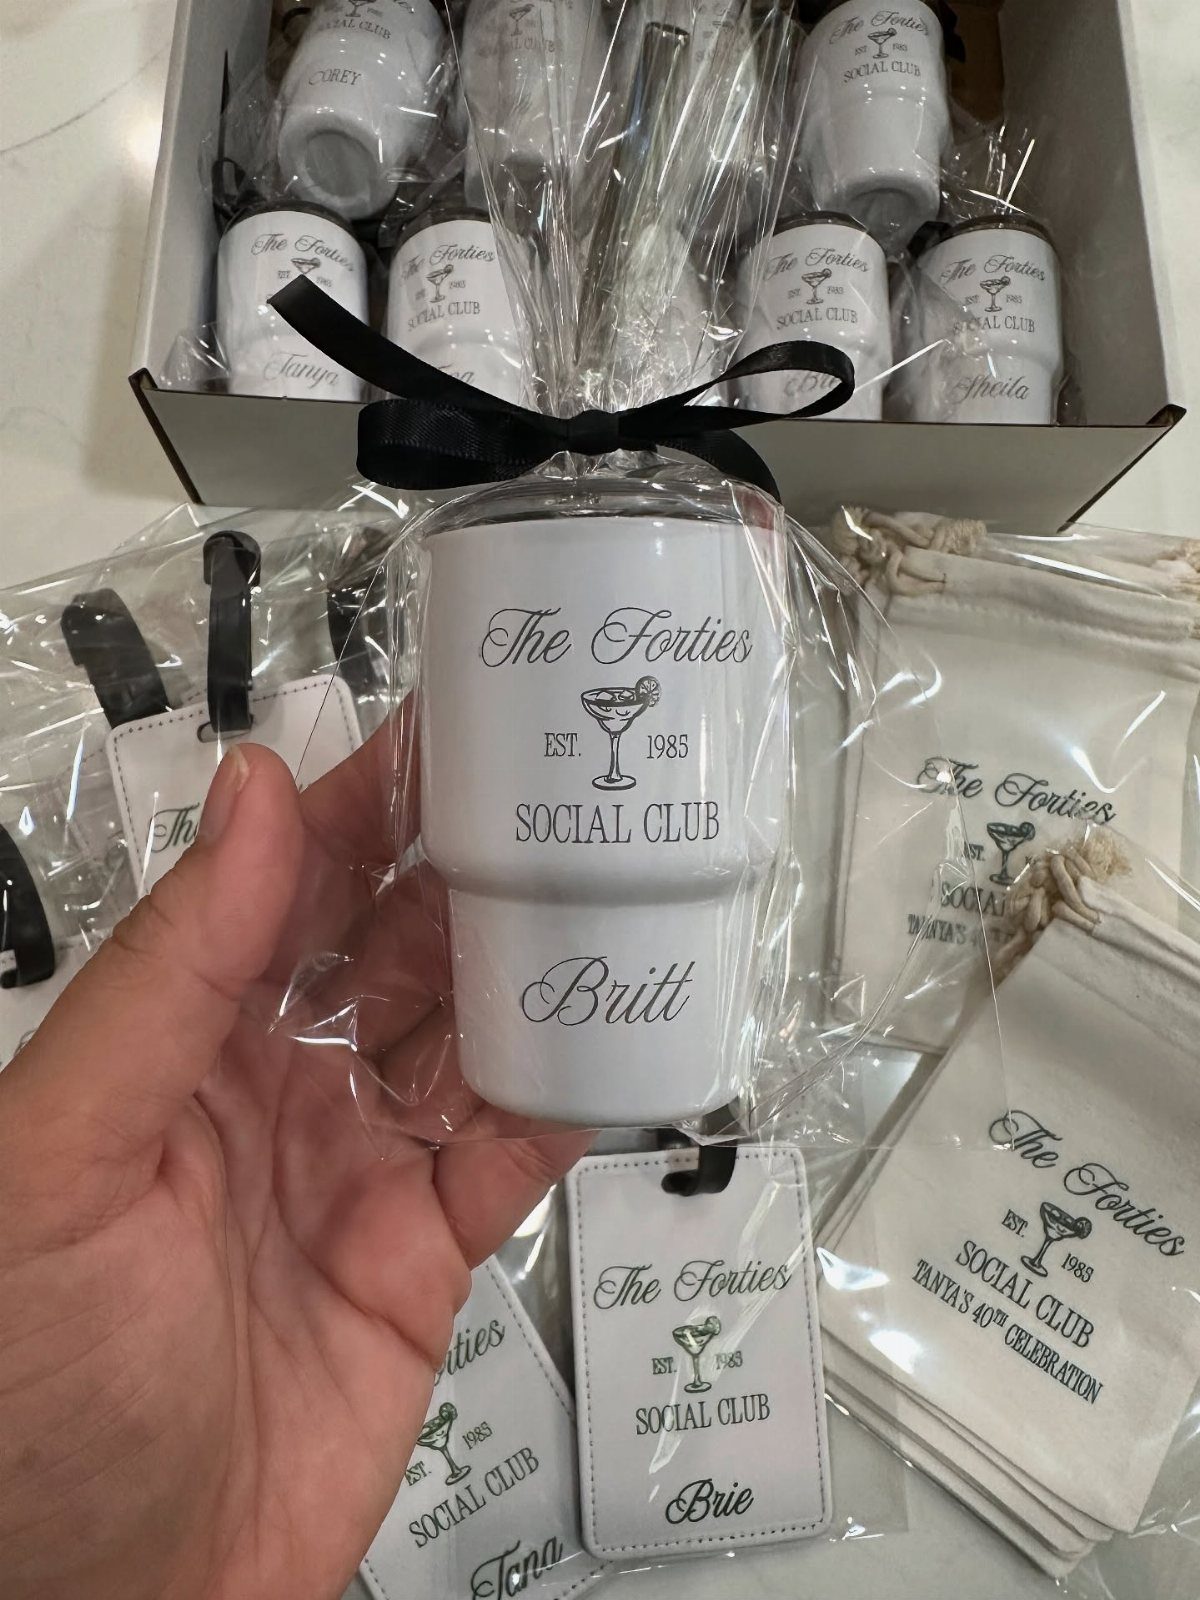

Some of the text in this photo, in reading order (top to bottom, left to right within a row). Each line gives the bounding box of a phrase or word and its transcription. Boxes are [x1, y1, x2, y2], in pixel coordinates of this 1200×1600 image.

[829, 10, 930, 45] The Forties
[308, 69, 362, 86] COREY
[844, 61, 921, 83] SOCIAL CLUB
[251, 233, 354, 272] The Forties
[429, 244, 496, 266] Forties
[763, 248, 868, 282] The Forties
[940, 255, 1046, 285] The Forties
[448, 301, 480, 316] CLUB
[777, 307, 858, 330] SOCIAL CLUB
[1004, 316, 1035, 333] CLUB
[263, 351, 340, 389] Tanya
[952, 375, 1030, 406] Sheila
[481, 606, 753, 667] The Forties
[544, 733, 689, 759] EST. 1985
[145, 801, 200, 853] Th
[515, 801, 720, 844] SOCIAL CLUB
[521, 956, 696, 1026] Britt
[989, 1110, 1185, 1256] The Forties
[1001, 1209, 1094, 1283] EST. 1985
[593, 1260, 793, 1309] The Forties
[955, 1240, 1095, 1348] SOCIAL CLUB
[911, 1258, 975, 1314] TANYA'S
[1004, 1323, 1104, 1404] CELEBRATION
[635, 1393, 771, 1435] SOCIAL CLUB
[461, 1421, 494, 1451] 1985
[408, 1446, 540, 1548] SOCIAL CLUB
[665, 1478, 754, 1524] Brie
[470, 1536, 563, 1600] Tana
